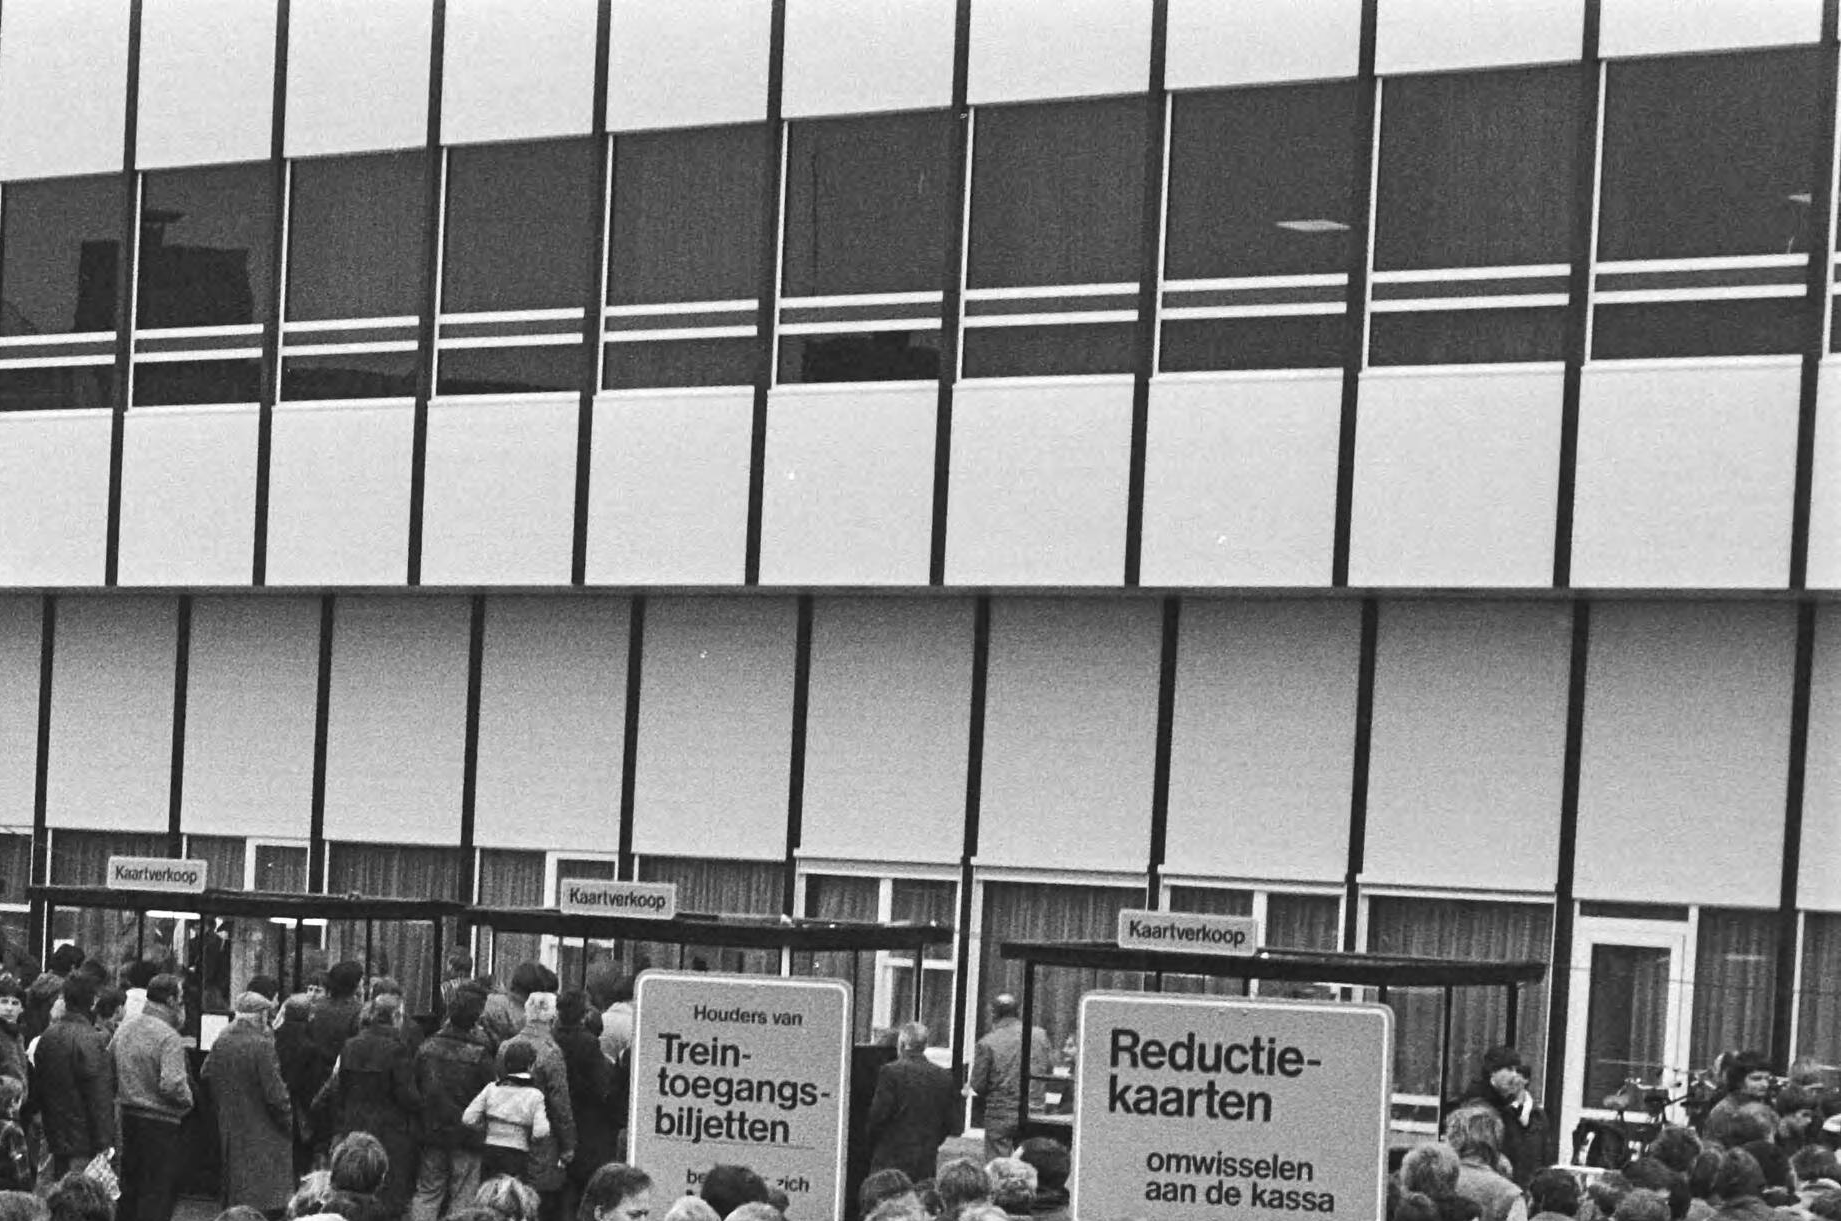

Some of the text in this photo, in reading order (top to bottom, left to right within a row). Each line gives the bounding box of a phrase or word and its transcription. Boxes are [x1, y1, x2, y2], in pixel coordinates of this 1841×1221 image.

[115, 865, 198, 885] Kaartverkoop
[569, 887, 666, 912] Kaartverkoop
[1129, 920, 1246, 949] Kaartverkoop
[694, 1005, 803, 1027] Houders van
[658, 1033, 751, 1067] Trein-
[1110, 1028, 1322, 1078] Reductie-
[657, 1067, 831, 1111] toegangs-
[1109, 1074, 1273, 1122] kaarten
[655, 1104, 790, 1144] biljetten
[1146, 1151, 1313, 1182] omwisselen
[1145, 1180, 1335, 1212] aan de kassa
